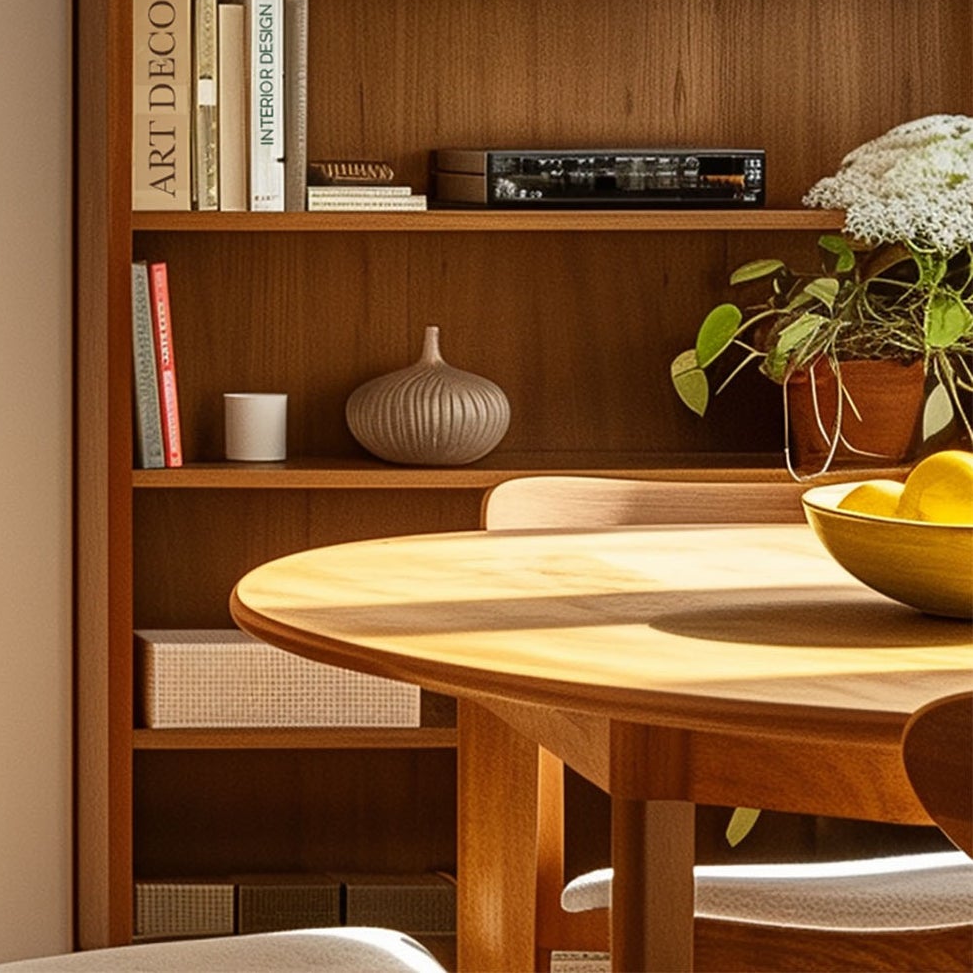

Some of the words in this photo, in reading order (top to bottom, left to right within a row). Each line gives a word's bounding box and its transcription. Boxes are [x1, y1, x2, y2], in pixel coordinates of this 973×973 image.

[148, 0, 176, 111] DECO
[259, 4, 274, 64] DESIGN
[259, 67, 274, 145] INTERIOR
[148, 121, 176, 197] ART
